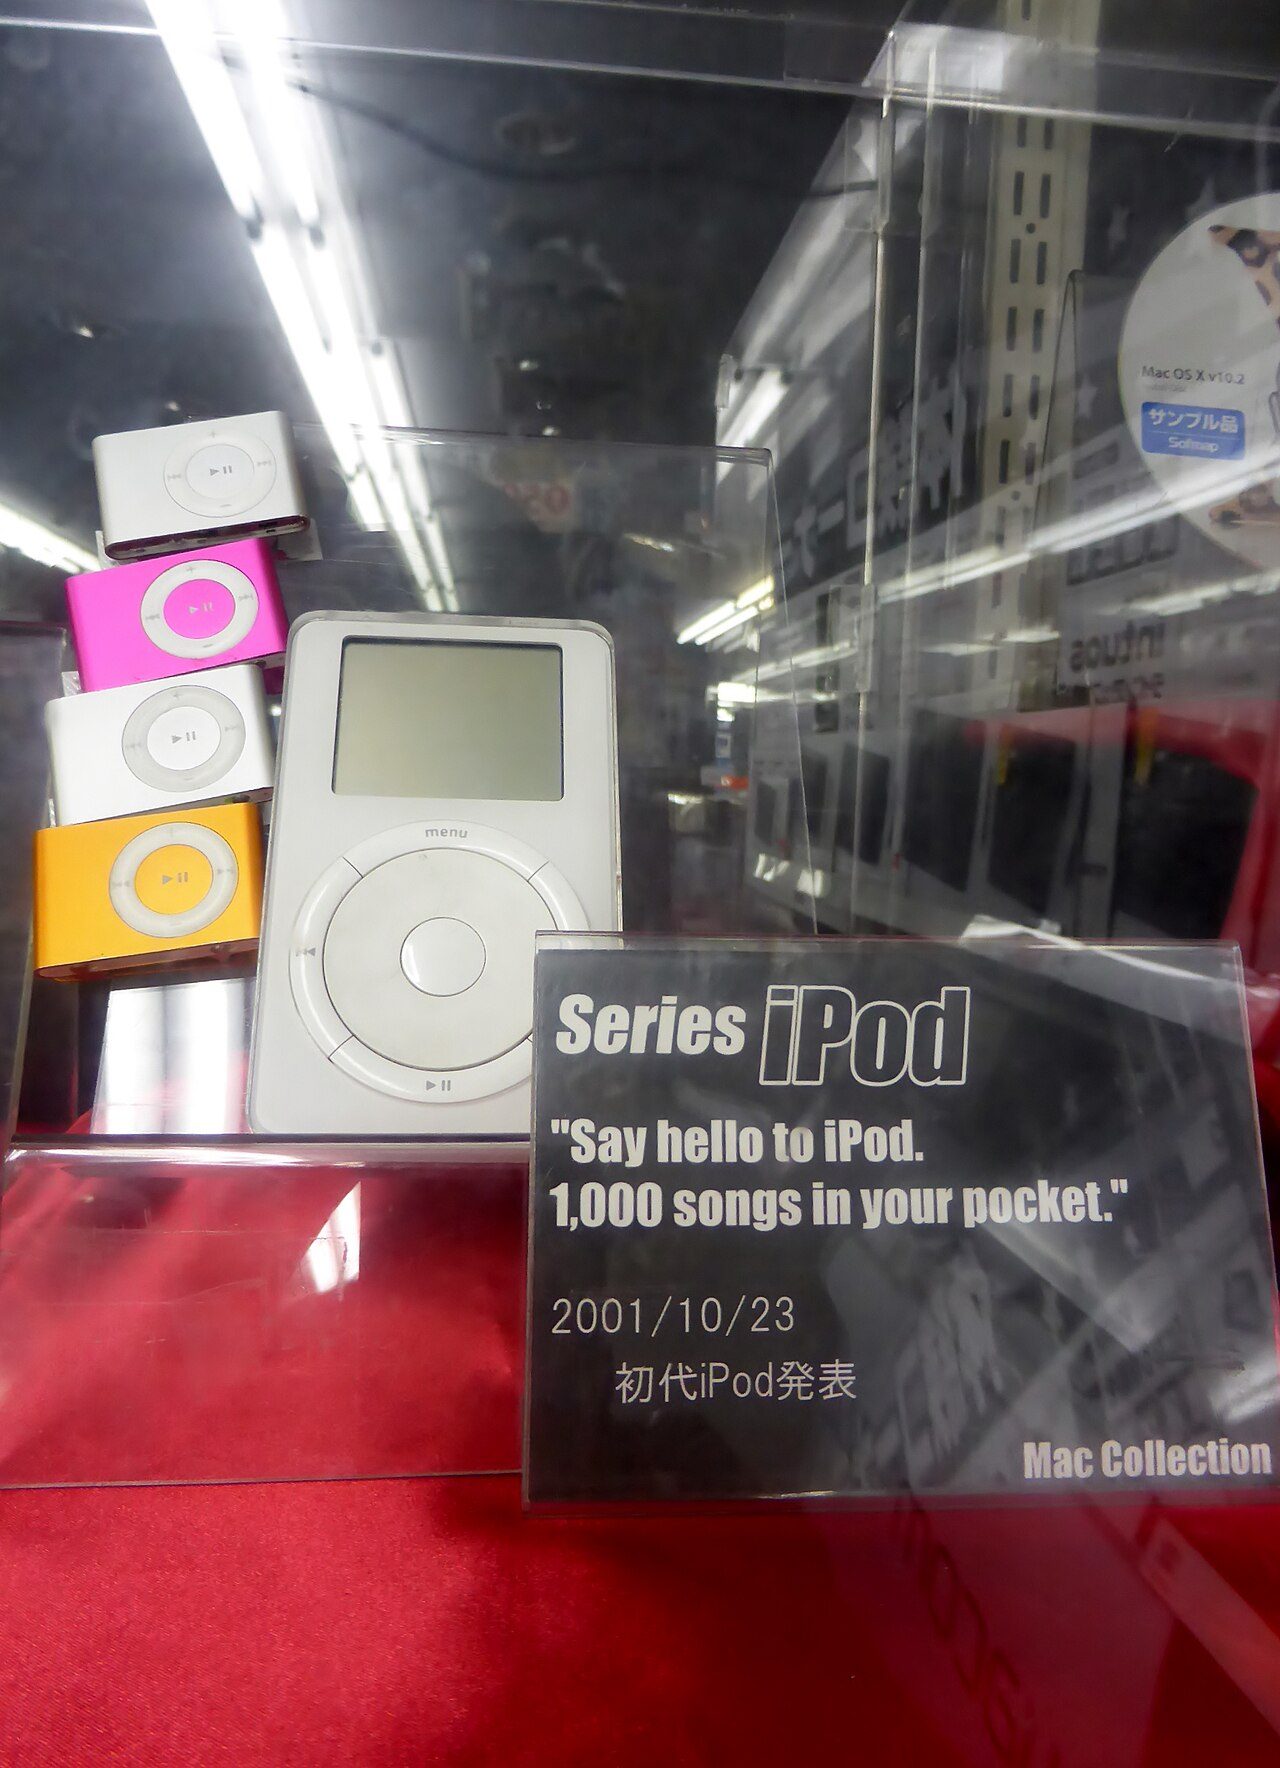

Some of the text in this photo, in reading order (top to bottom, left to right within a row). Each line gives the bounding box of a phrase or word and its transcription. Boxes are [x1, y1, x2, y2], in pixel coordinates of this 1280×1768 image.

[1142, 365, 1245, 385] Mac OS X v10.2
[425, 828, 468, 838] menu
[555, 984, 971, 1087] Series iPod
[550, 1118, 924, 1167] "Say hello to iPod.
[549, 1178, 1128, 1232] 1,000 songs in your pocket."
[551, 1295, 796, 1337] 2001/10/23
[615, 1358, 857, 1404] 初代iPod発表
[1022, 1438, 1272, 1479] Mac Collection
